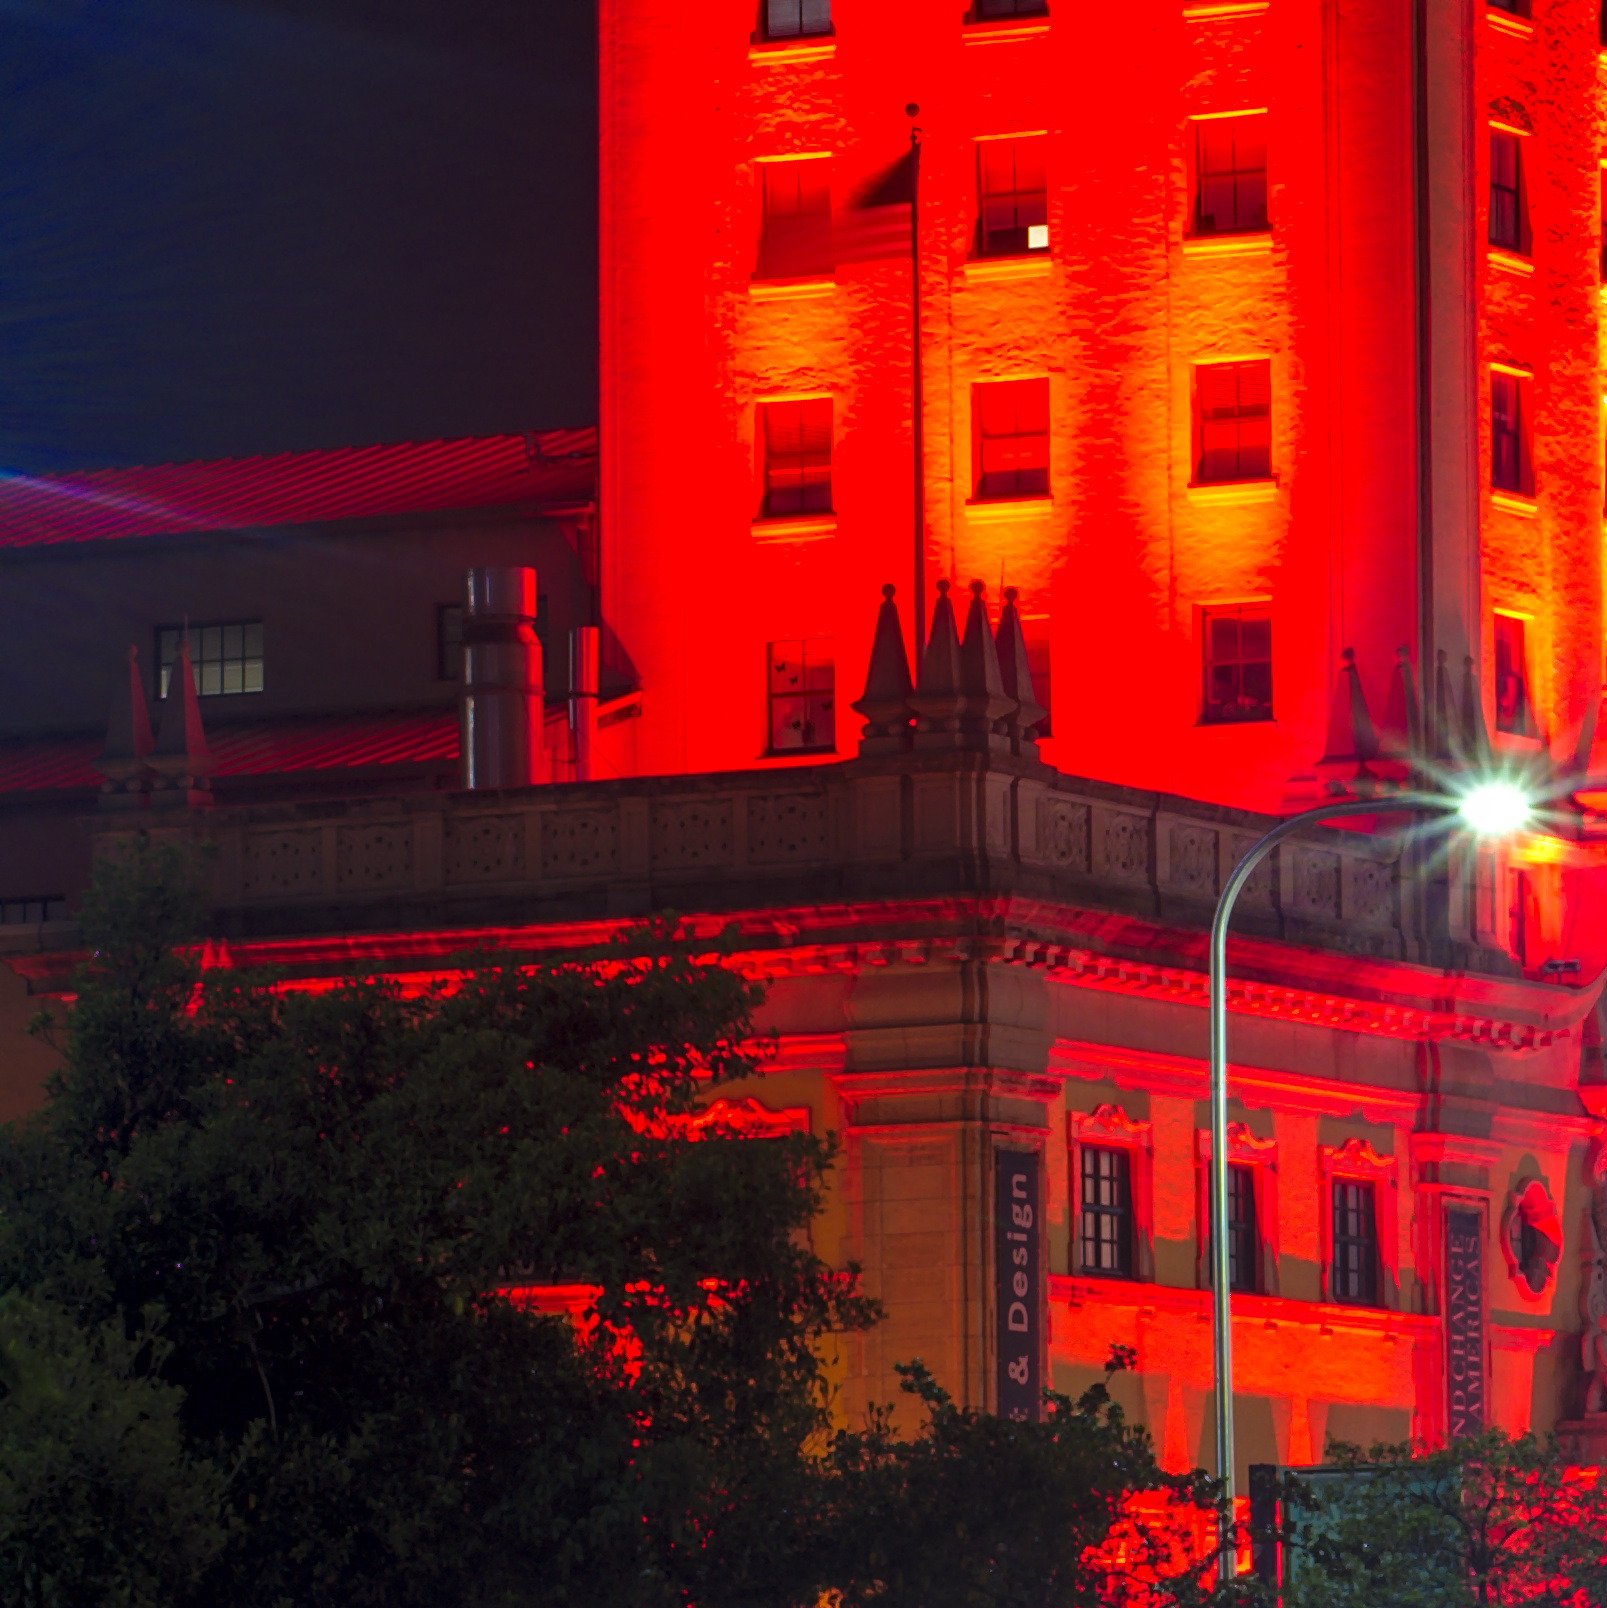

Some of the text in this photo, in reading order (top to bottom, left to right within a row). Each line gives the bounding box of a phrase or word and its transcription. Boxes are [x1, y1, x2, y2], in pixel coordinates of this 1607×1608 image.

[1007, 1173, 1033, 1333] Design
[1451, 1235, 1466, 1438] ND CHANGE
[1466, 1236, 1481, 1419] AMERICAS
[1008, 1355, 1030, 1385] &
